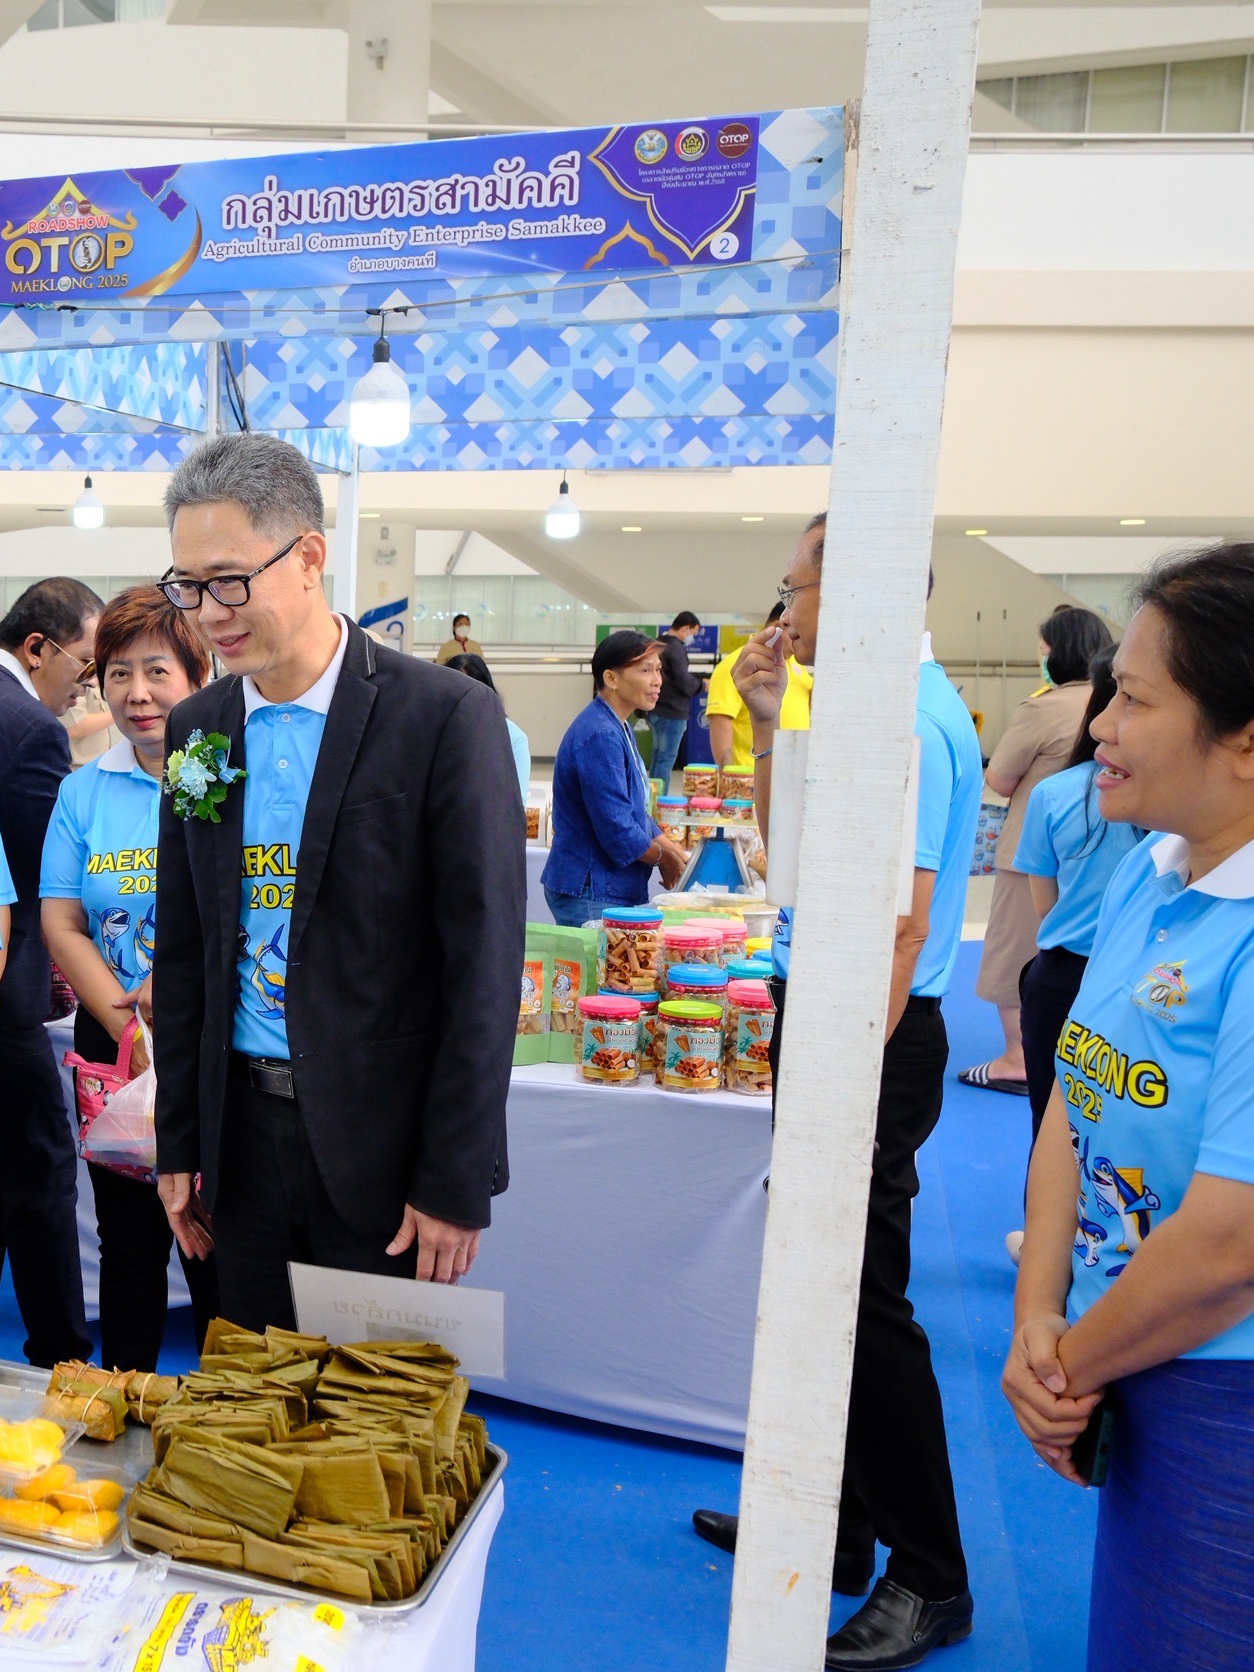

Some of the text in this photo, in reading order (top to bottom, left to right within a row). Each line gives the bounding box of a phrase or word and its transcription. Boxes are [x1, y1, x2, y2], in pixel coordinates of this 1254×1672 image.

[719, 133, 749, 144] OTOP
[731, 162, 751, 171] OTOP
[224, 155, 577, 239] กลุ่มเกษตรสามัคคี
[27, 215, 110, 233] ROADSHOW
[204, 217, 604, 257] Agricultural Community Enterprise Samakkee
[719, 237, 731, 254] 2
[6, 232, 134, 275] OTOP
[349, 253, 434, 271] อำเภอบางคนที
[11, 274, 129, 293] MAEKLONG 2025
[1057, 1018, 1170, 1109] EKLONG
